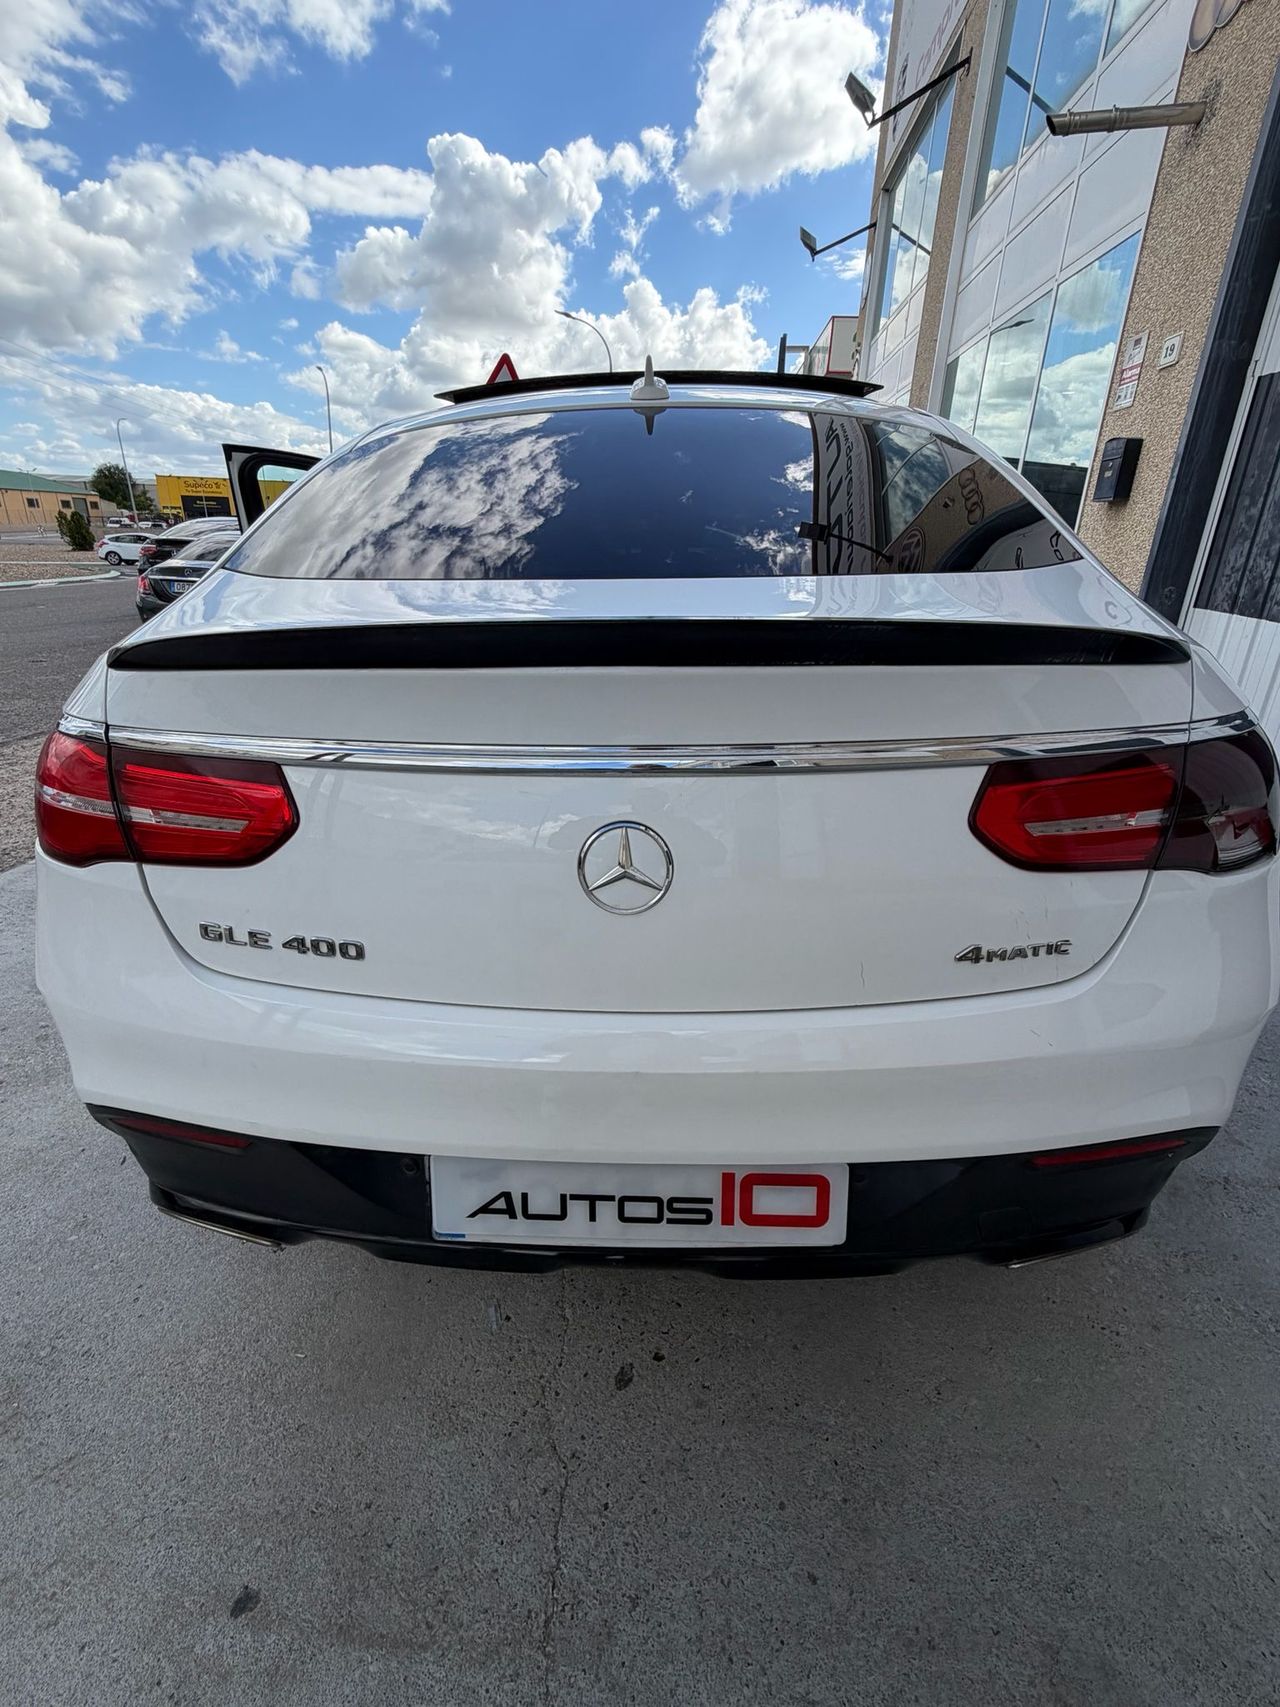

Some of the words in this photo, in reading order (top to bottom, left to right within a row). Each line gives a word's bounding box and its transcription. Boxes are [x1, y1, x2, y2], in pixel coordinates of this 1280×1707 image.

[1163, 343, 1175, 359] 19
[184, 480, 213, 489] Supeco
[176, 583, 193, 591] 087
[199, 920, 273, 950] GLE
[281, 934, 366, 961] 400
[954, 939, 1073, 964] 4MATIC
